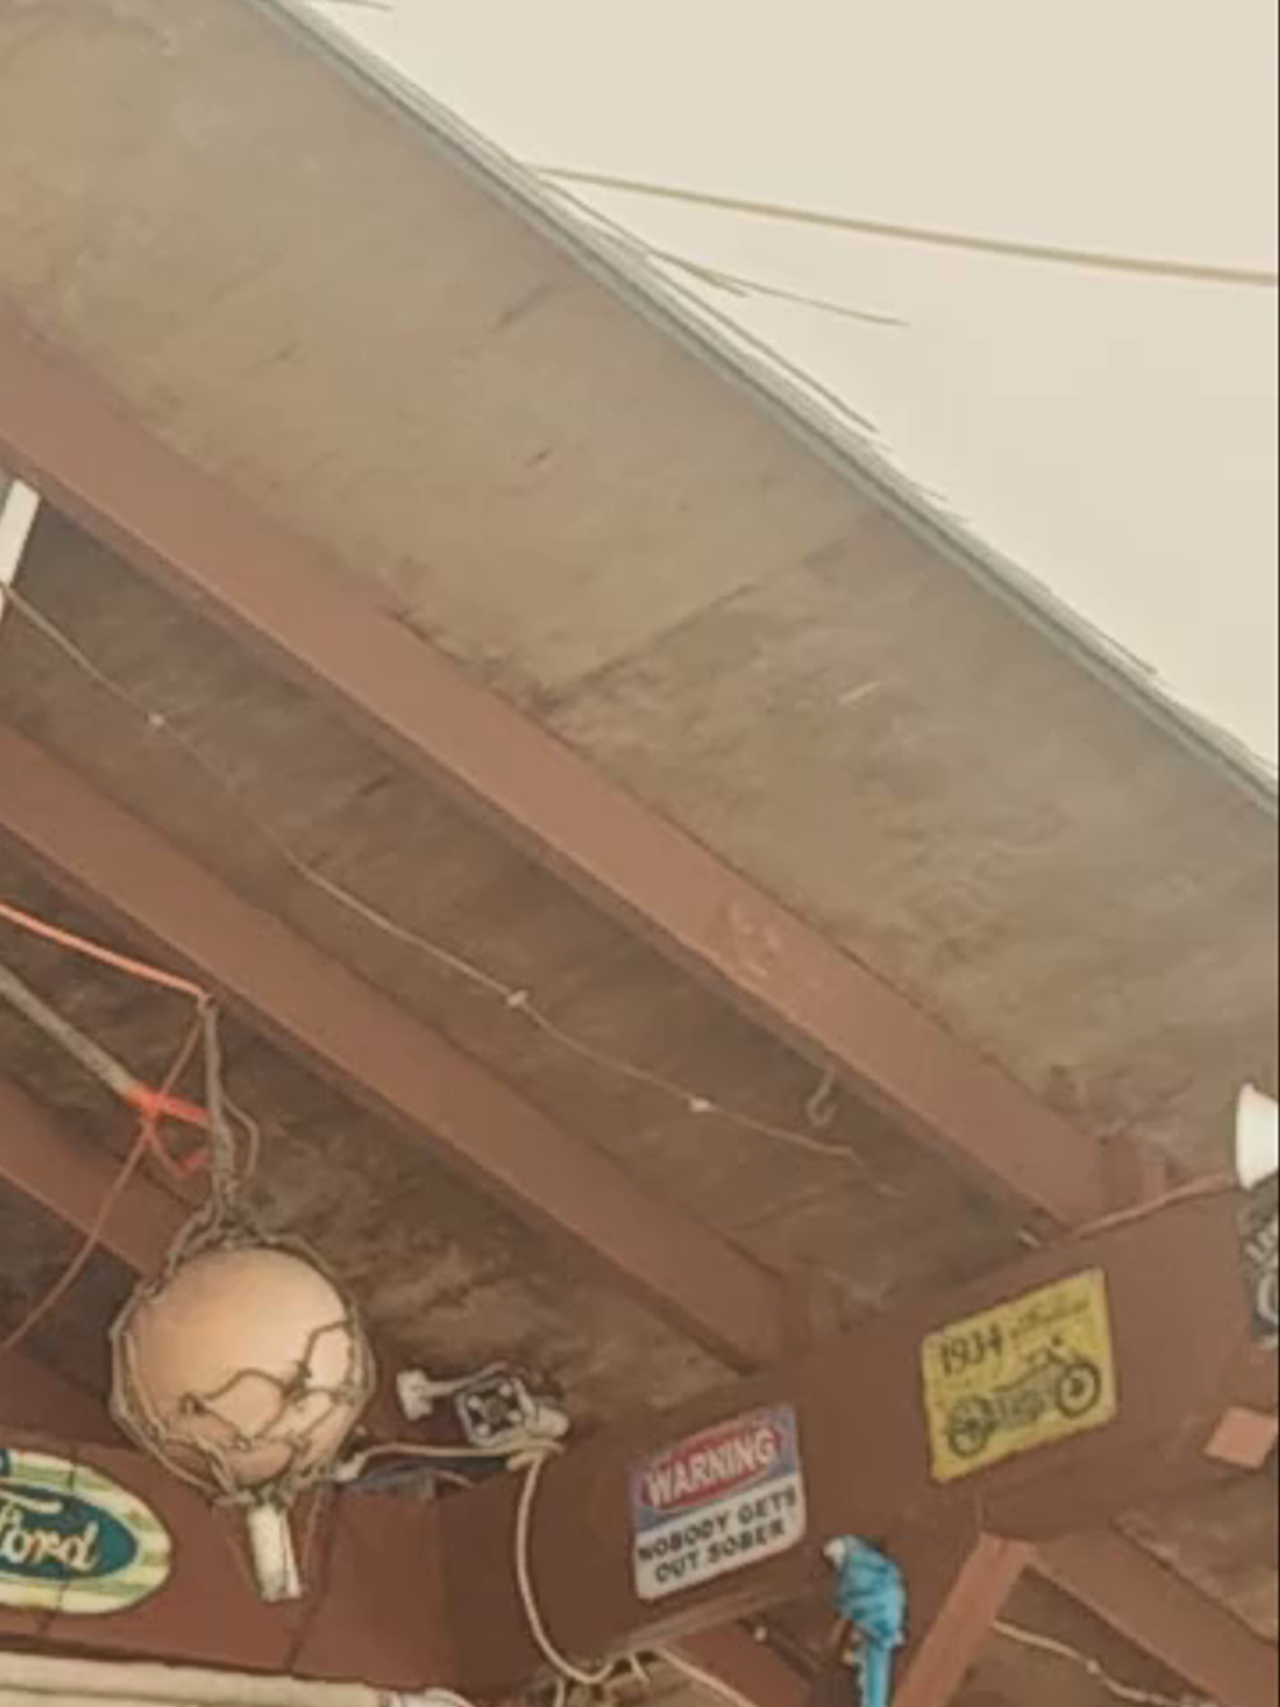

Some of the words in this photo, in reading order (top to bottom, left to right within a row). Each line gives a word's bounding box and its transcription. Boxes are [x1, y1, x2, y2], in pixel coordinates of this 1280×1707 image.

[645, 1426, 778, 1509] WARNING
[639, 1509, 730, 1560] NOBODY
[737, 1485, 796, 1525] GETS
[654, 1549, 701, 1583] OUT
[707, 1519, 786, 1564] SOBER
